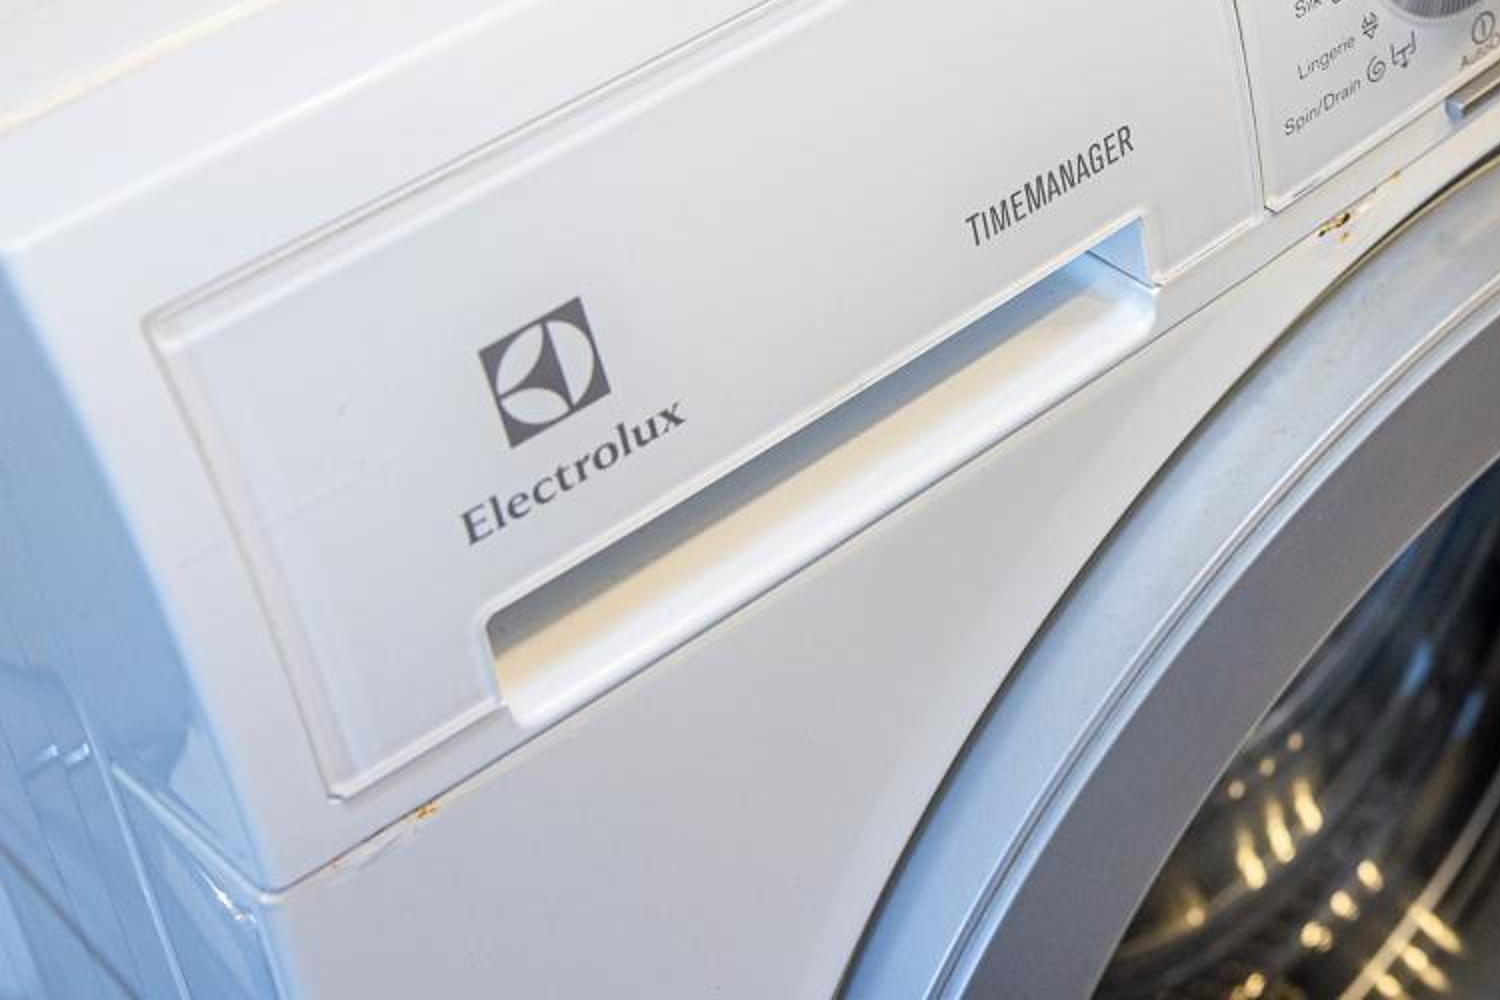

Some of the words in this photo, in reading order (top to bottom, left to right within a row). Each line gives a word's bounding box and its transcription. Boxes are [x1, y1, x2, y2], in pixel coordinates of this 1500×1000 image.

[1297, 35, 1356, 80] Lingerie
[1283, 78, 1361, 136] Spin/Drain
[964, 124, 1135, 248] TIMEMANAGER
[458, 400, 687, 545] Electrolux
